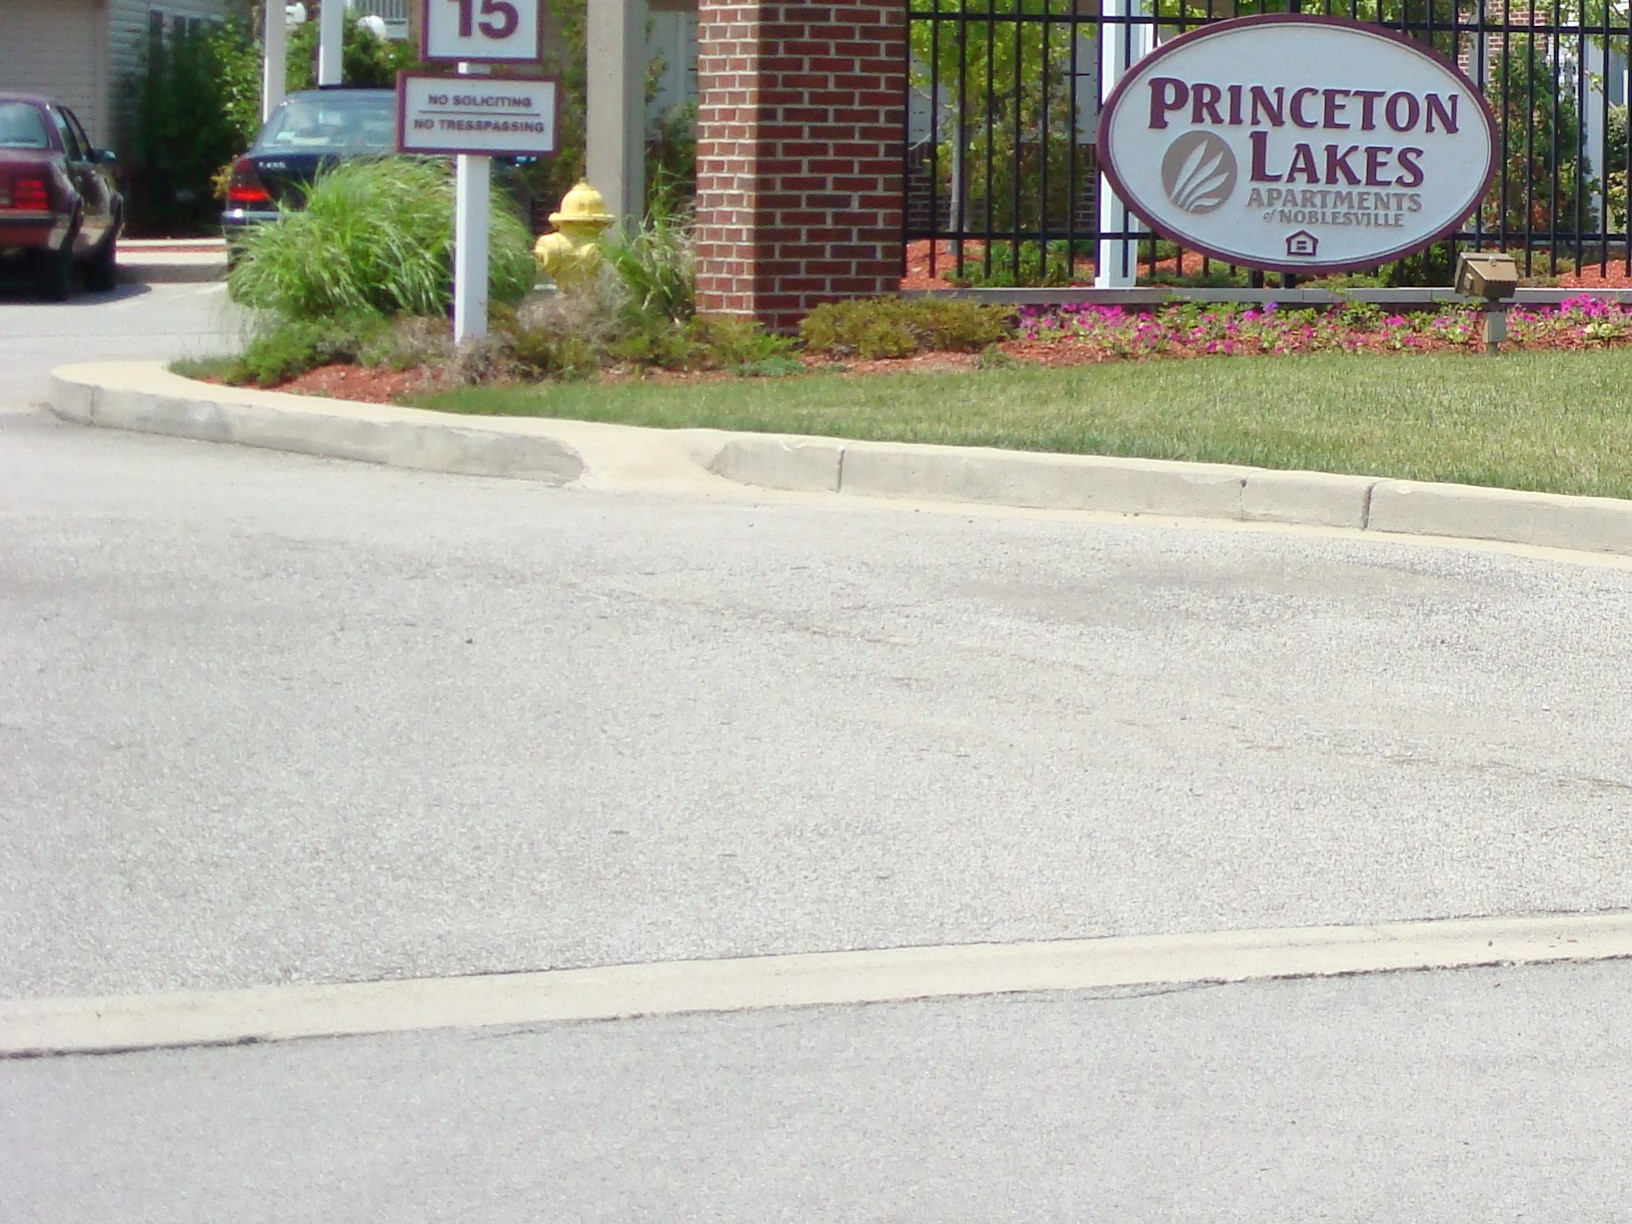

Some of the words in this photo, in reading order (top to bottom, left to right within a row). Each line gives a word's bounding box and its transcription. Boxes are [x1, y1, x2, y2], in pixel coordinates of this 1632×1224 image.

[428, 94, 448, 105] NO
[453, 95, 532, 108] SOLICITING
[1148, 77, 1460, 135] PRINCETON
[414, 119, 434, 130] NO
[439, 119, 544, 133] TRESSPASSING
[1249, 130, 1424, 188] LAKES
[1247, 187, 1422, 212] APARTMENTS
[1263, 209, 1276, 222] of
[1279, 210, 1404, 227] NOBLESVILLE
